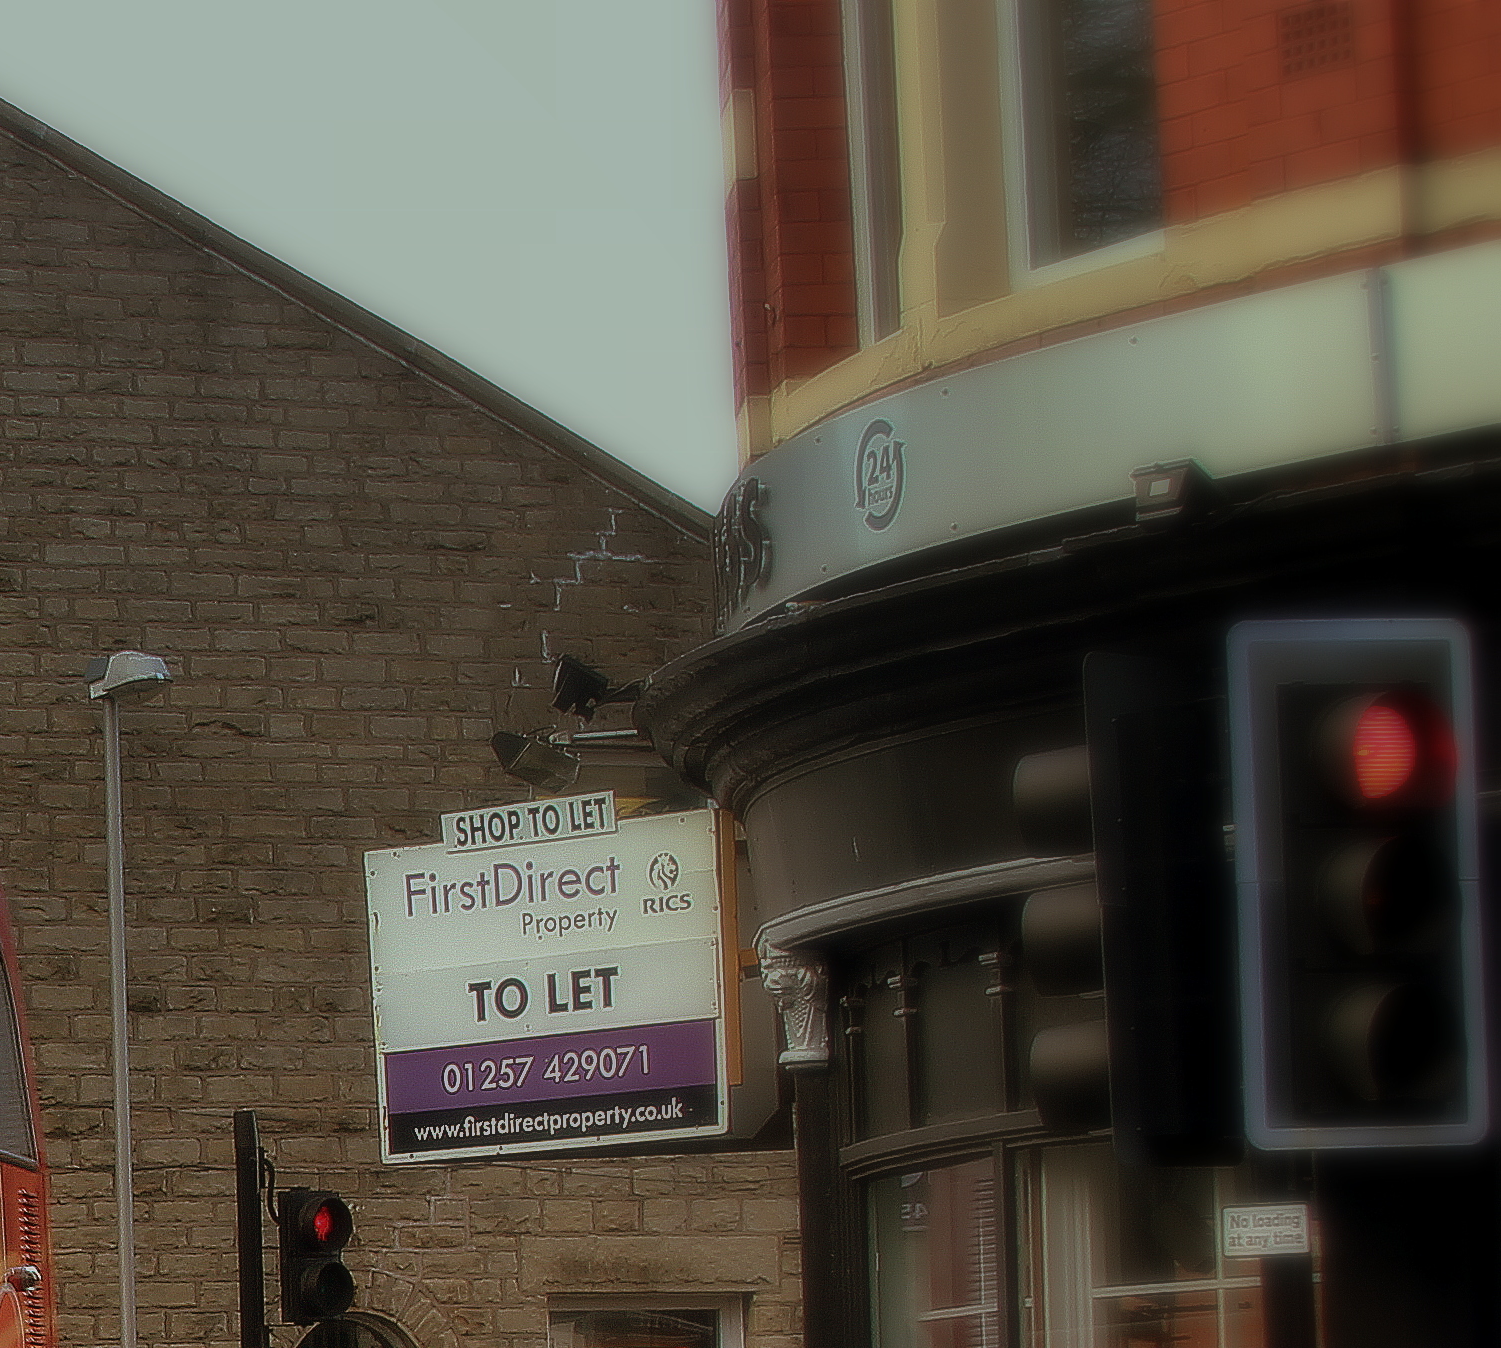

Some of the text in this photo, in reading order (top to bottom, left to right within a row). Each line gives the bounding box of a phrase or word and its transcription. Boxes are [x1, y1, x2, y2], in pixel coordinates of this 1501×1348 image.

[867, 444, 892, 485] 24
[455, 797, 608, 848] SHOP TO LET
[404, 856, 622, 918] FirstDirect
[642, 893, 692, 914] RICS
[522, 907, 618, 937] Property
[468, 966, 620, 1023] TO LET
[442, 1044, 651, 1095] 01257 429071
[414, 1097, 684, 1142] www.firstdirectproperty.co.uk
[1229, 1231, 1304, 1248] at any time
[1230, 1212, 1300, 1229] No loading
